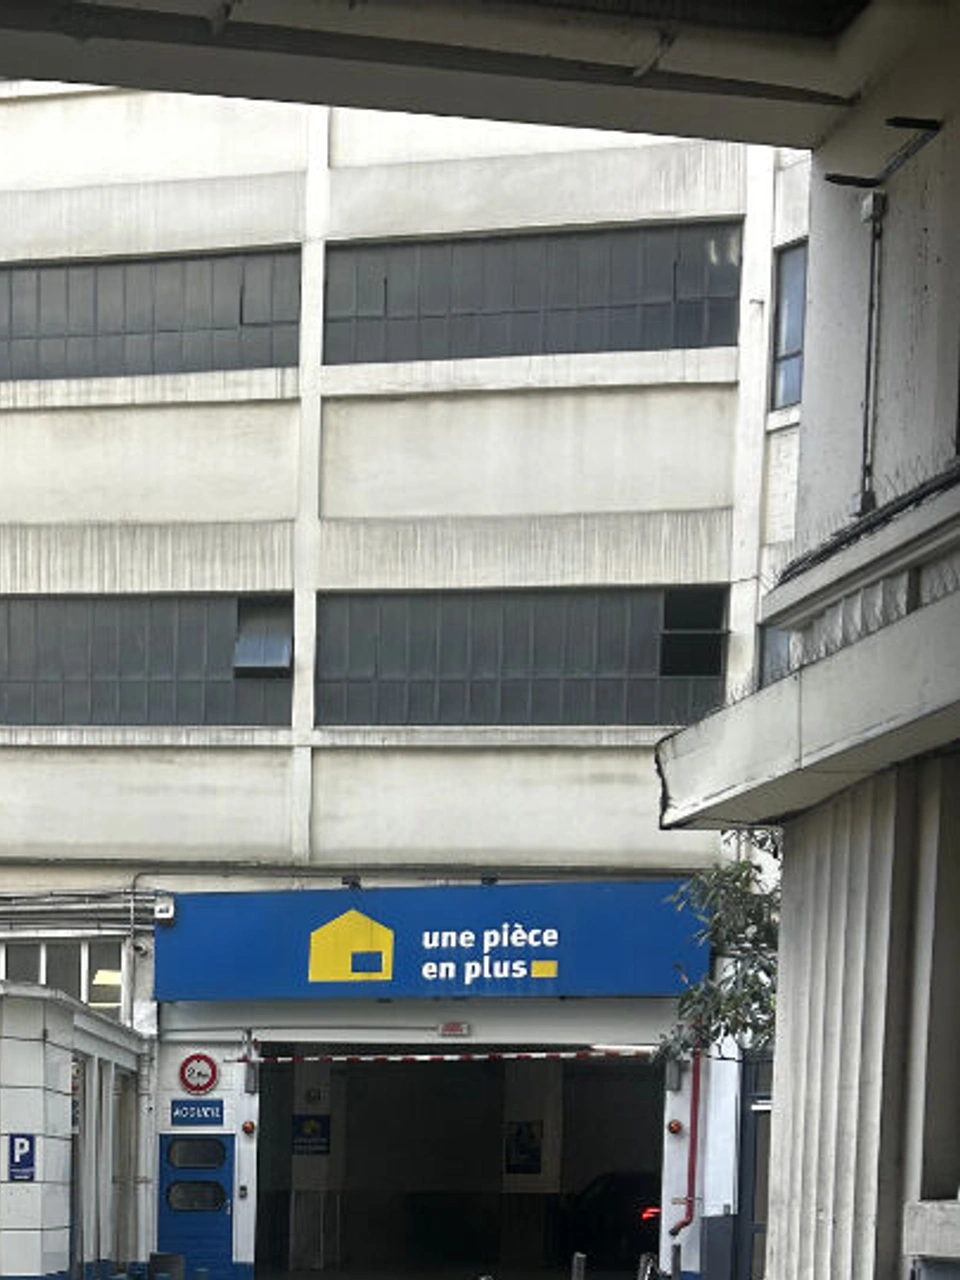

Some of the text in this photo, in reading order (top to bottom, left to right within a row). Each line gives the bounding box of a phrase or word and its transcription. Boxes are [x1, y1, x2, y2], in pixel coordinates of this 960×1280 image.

[423, 922, 558, 954] une pièce
[421, 955, 528, 985] en plus
[14, 1138, 30, 1163] P
